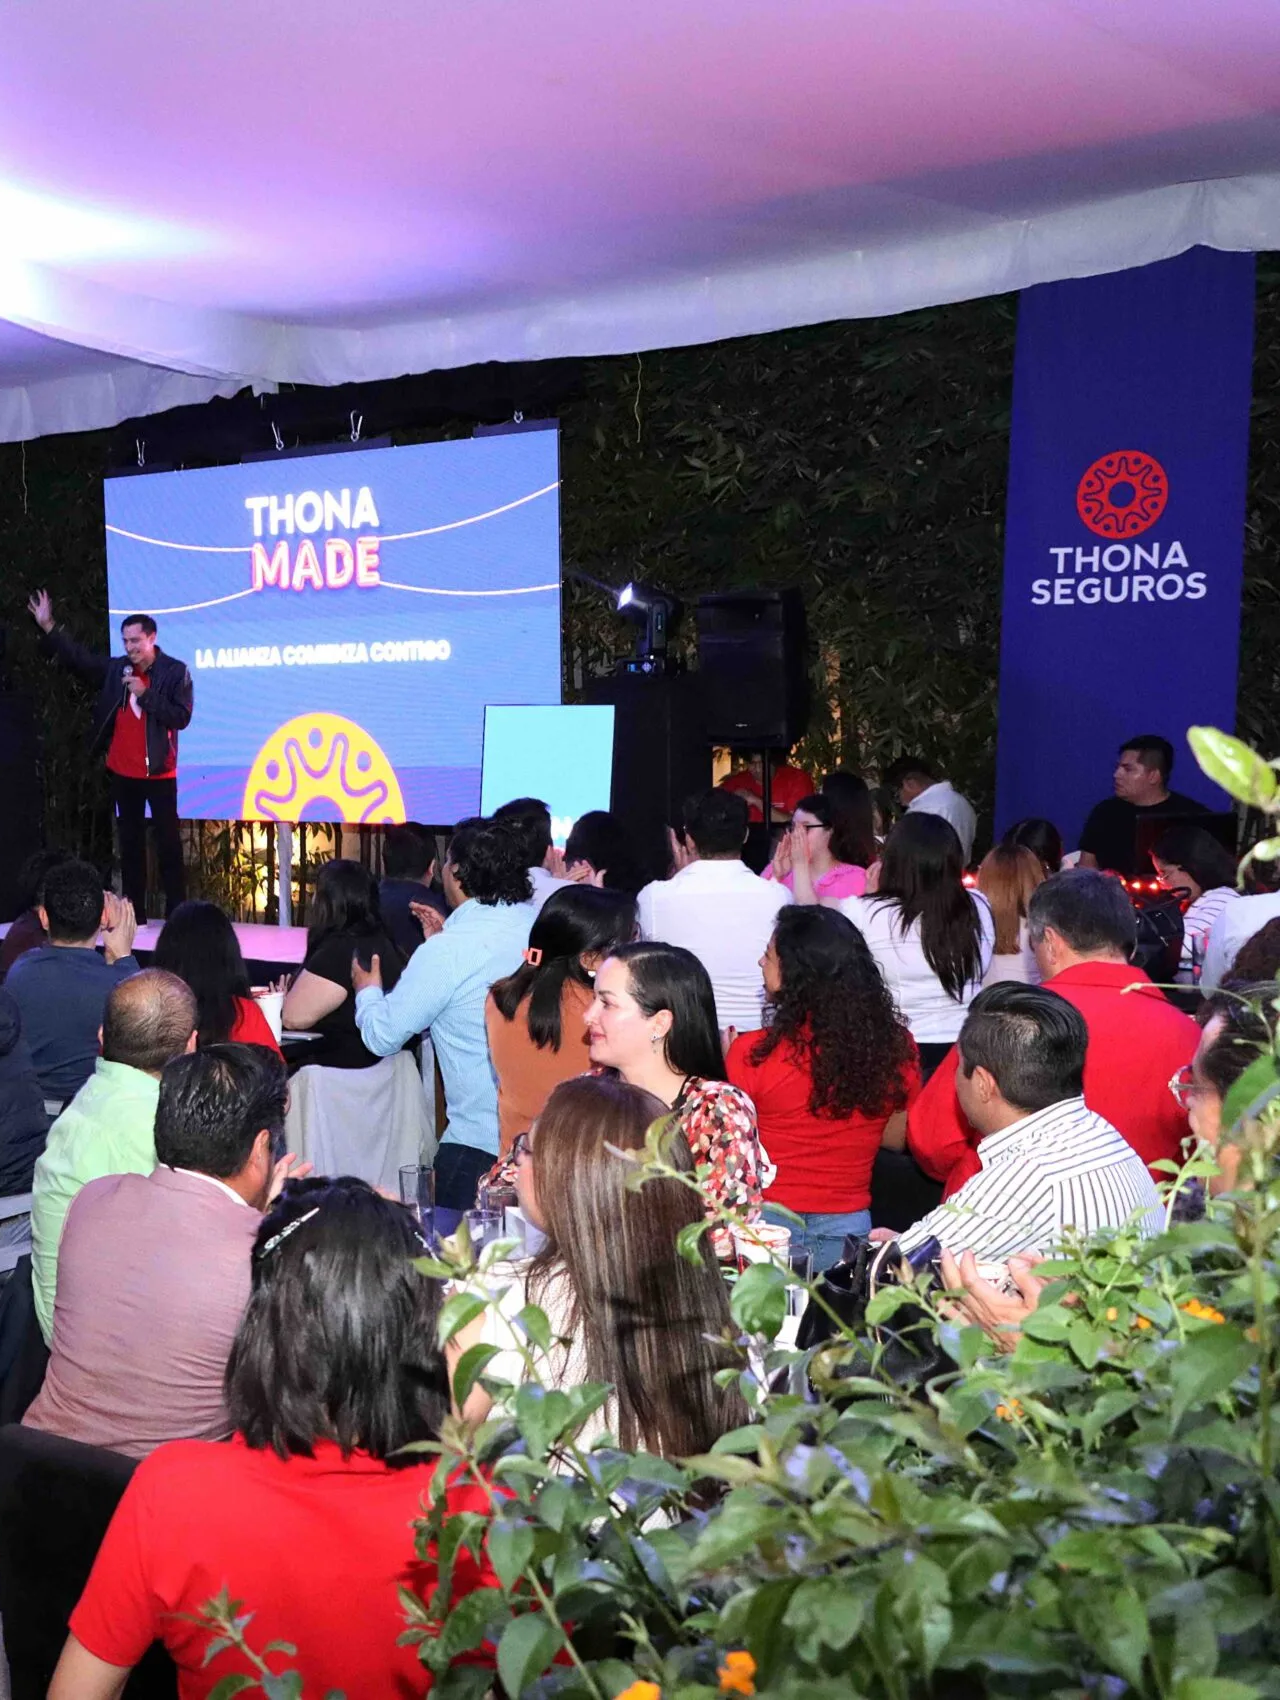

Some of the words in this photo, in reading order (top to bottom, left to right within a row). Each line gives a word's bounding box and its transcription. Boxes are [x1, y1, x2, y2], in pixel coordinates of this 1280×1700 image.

[245, 486, 380, 537] THONA
[252, 536, 381, 592] MADE
[1049, 541, 1189, 574] THONA
[1031, 572, 1208, 605] SEGUROS
[195, 648, 215, 669] LA
